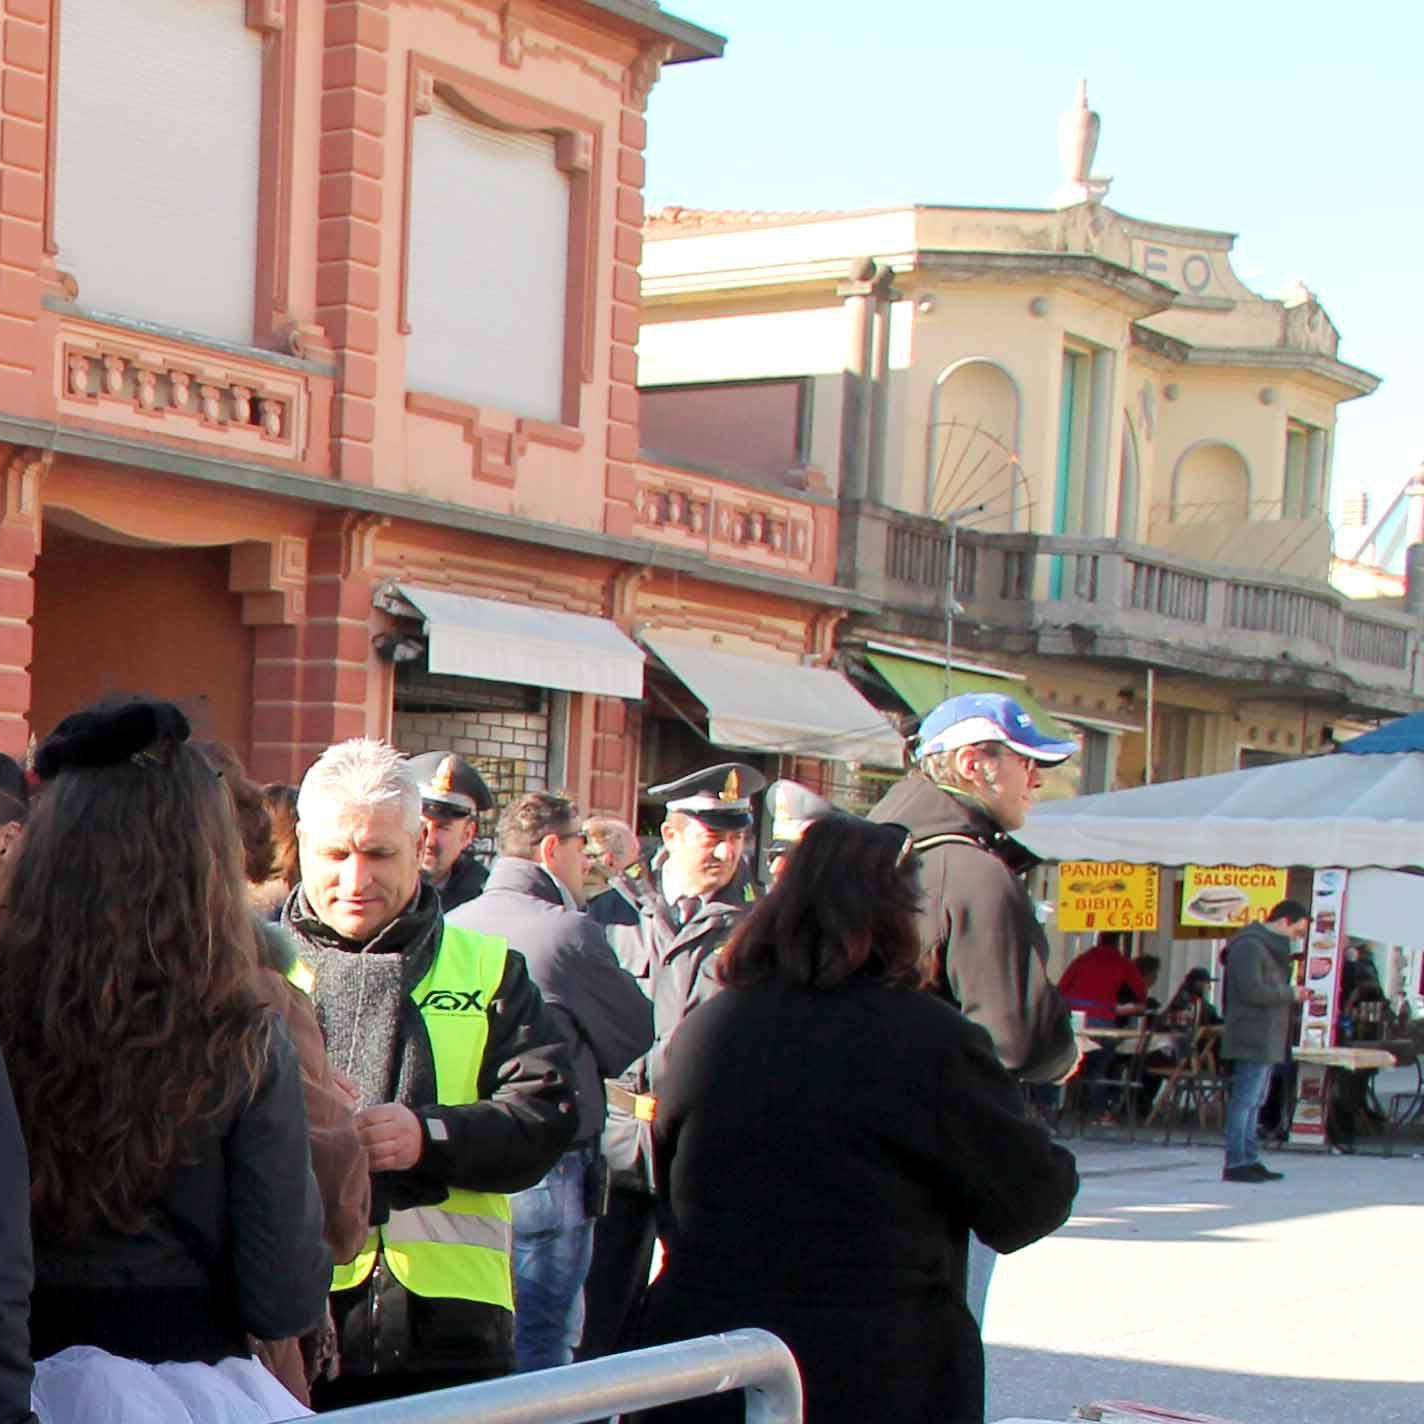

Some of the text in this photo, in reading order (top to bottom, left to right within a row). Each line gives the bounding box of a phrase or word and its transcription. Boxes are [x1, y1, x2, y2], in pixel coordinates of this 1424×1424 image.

[1060, 863, 1136, 877] PANINO
[1193, 872, 1277, 887] SALSICCIA
[1075, 897, 1134, 911] BIBITA
